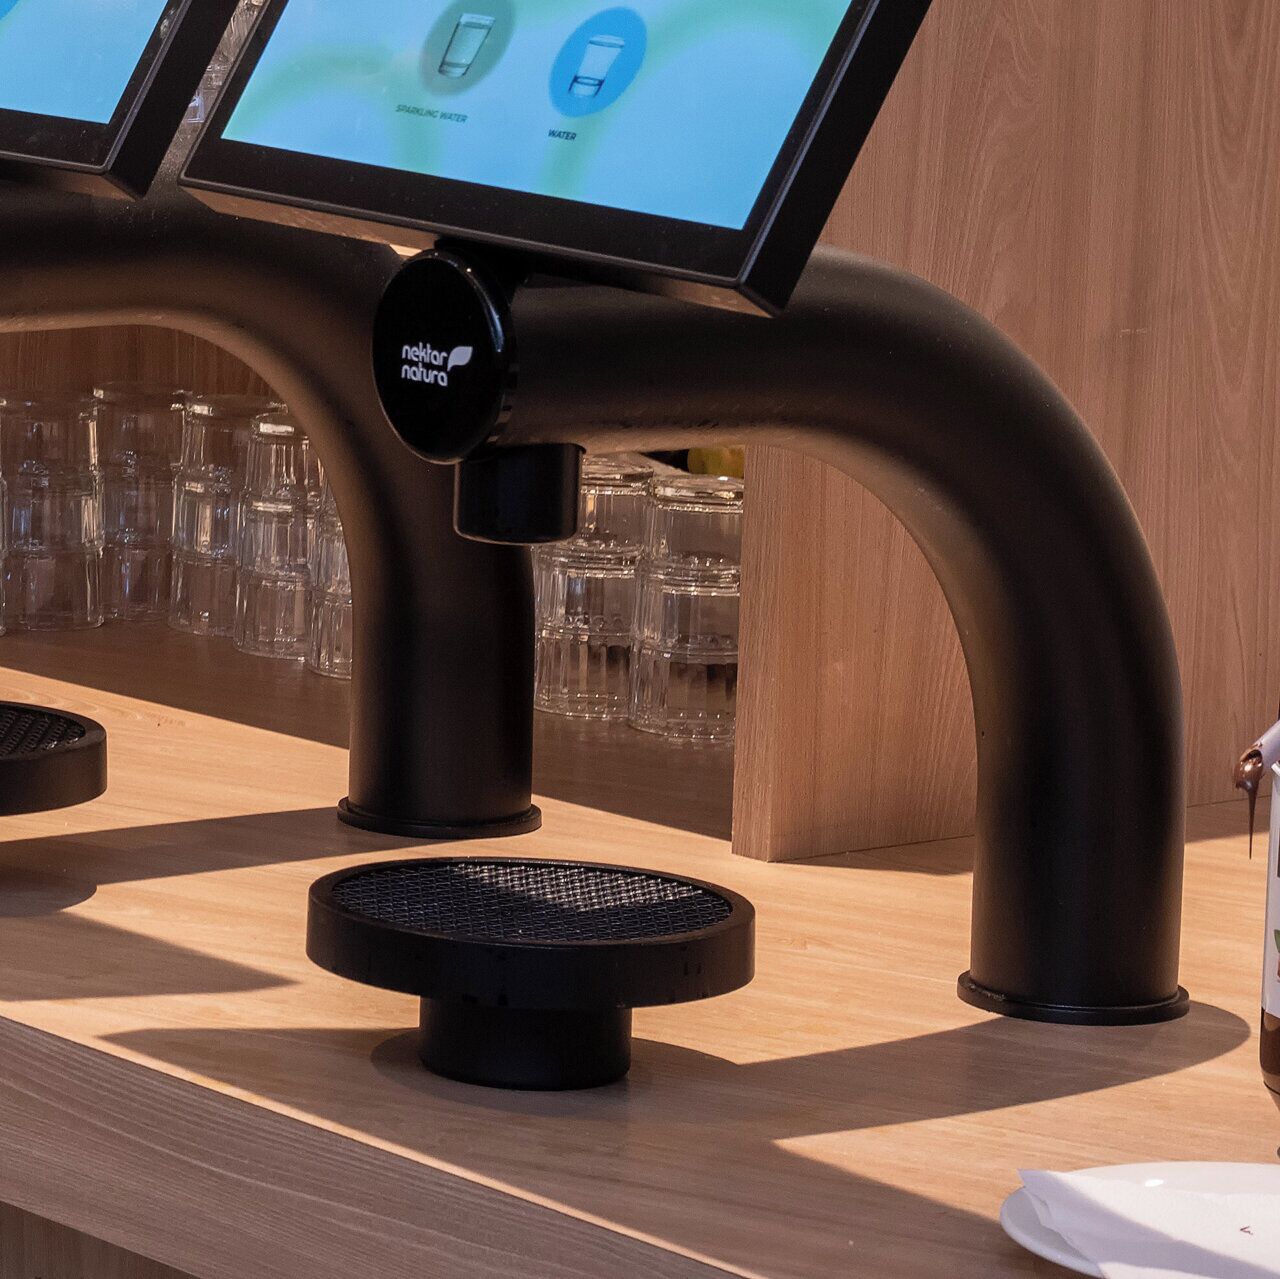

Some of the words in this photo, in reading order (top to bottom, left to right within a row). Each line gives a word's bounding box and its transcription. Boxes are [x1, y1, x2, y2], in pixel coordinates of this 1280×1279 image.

[395, 104, 439, 118] SPARKLING
[439, 111, 468, 123] WATER
[548, 129, 577, 141] WATER
[401, 342, 448, 366] nektar
[401, 362, 448, 387] natura
